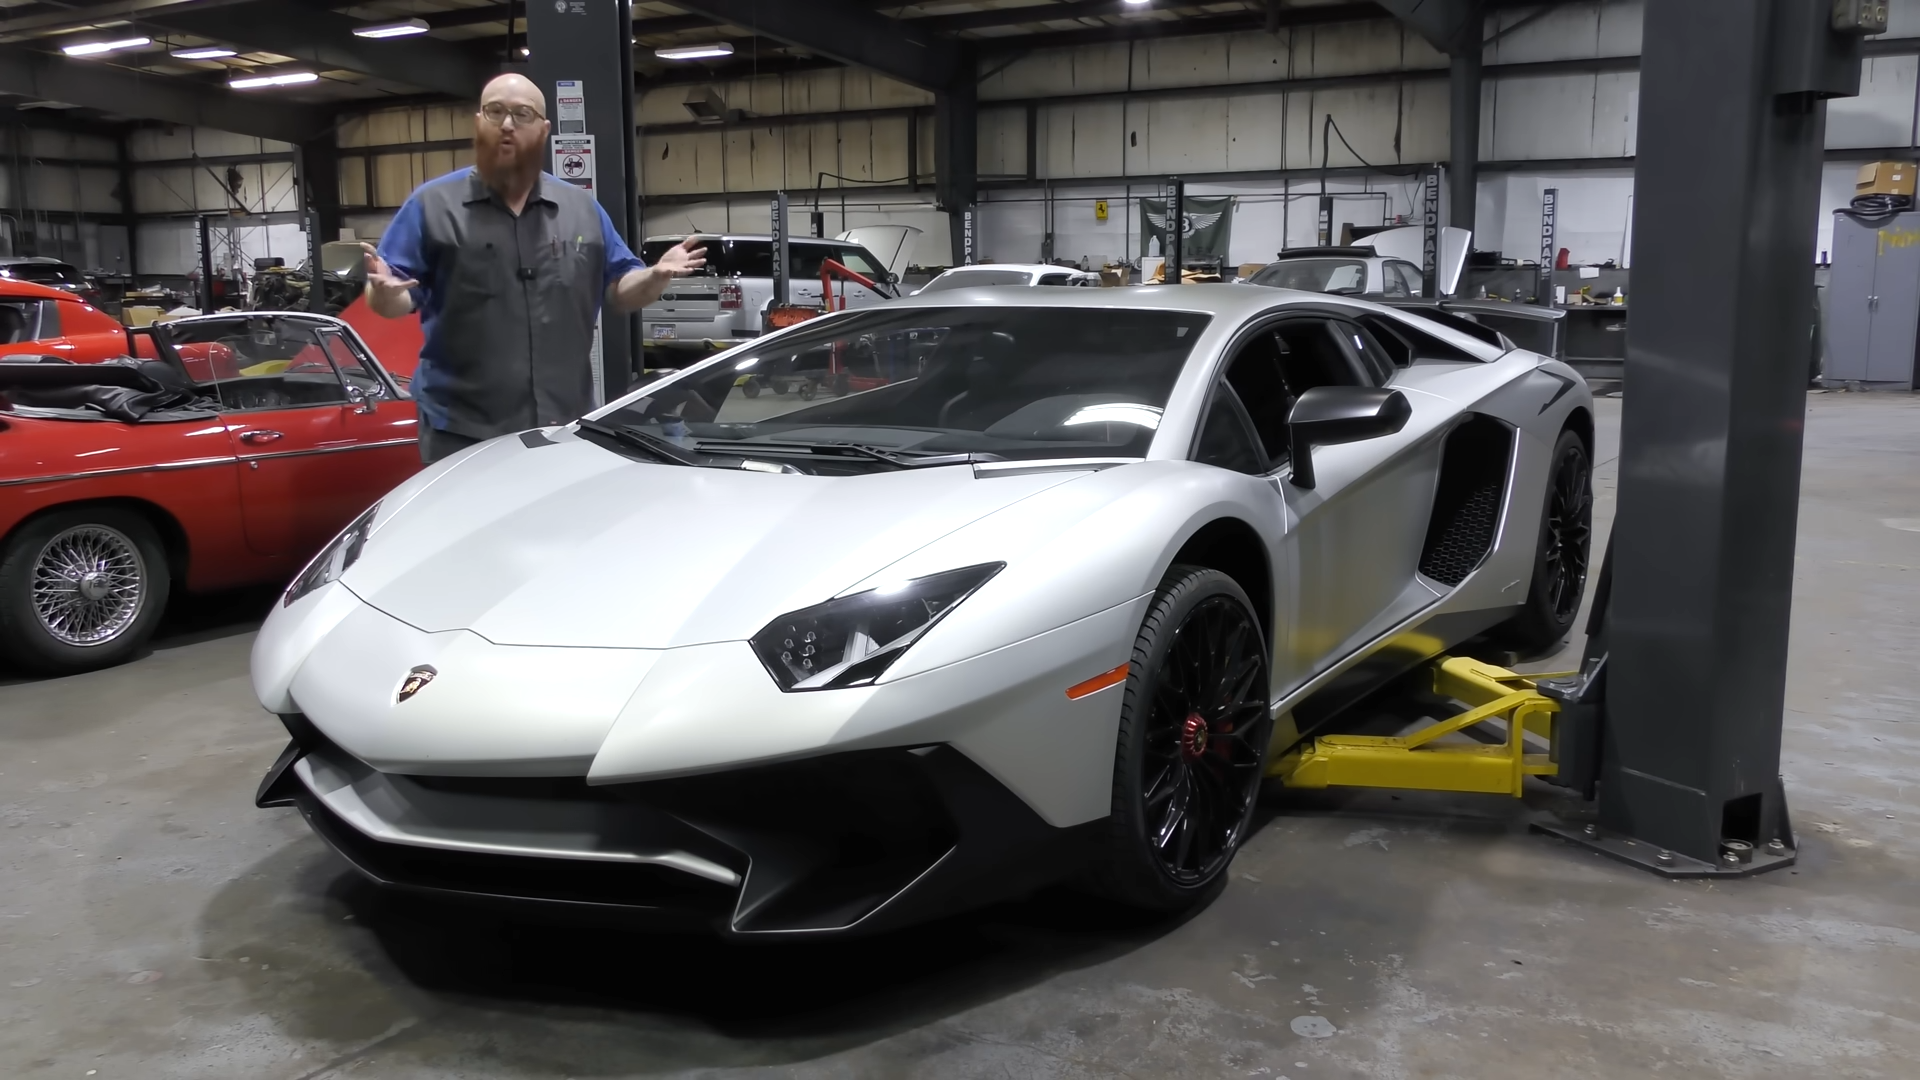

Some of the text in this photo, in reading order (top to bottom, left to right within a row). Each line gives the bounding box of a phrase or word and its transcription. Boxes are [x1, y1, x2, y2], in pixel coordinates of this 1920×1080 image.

[772, 200, 780, 271] BENDPAK
[1166, 185, 1176, 267] BENDPAK
[1424, 175, 1438, 264] BENDPAK
[1541, 194, 1554, 267] BENDPAK
